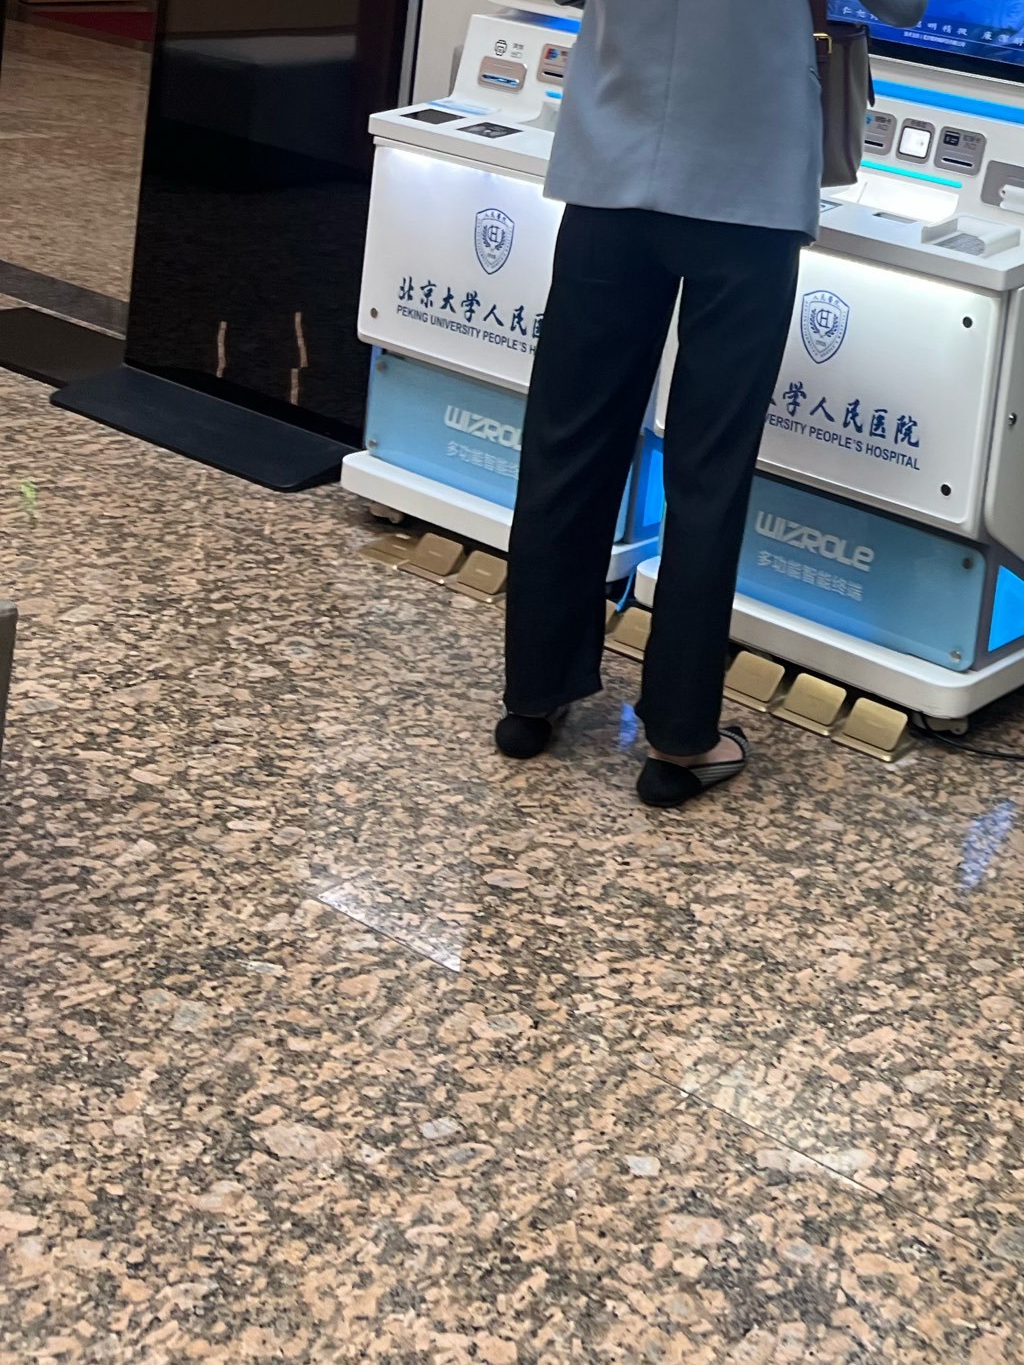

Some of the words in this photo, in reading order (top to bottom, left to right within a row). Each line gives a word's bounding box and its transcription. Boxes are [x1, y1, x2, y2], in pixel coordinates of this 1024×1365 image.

[397, 305, 428, 323] PEKING
[430, 314, 481, 338] UNIVERSITY
[483, 331, 527, 353] PEOPLE'S
[770, 381, 920, 448] 学人民医院
[808, 426, 863, 453] PEOPLE'S
[865, 443, 921, 471] HOSPITAL
[757, 550, 863, 602] 多功能智能终端
